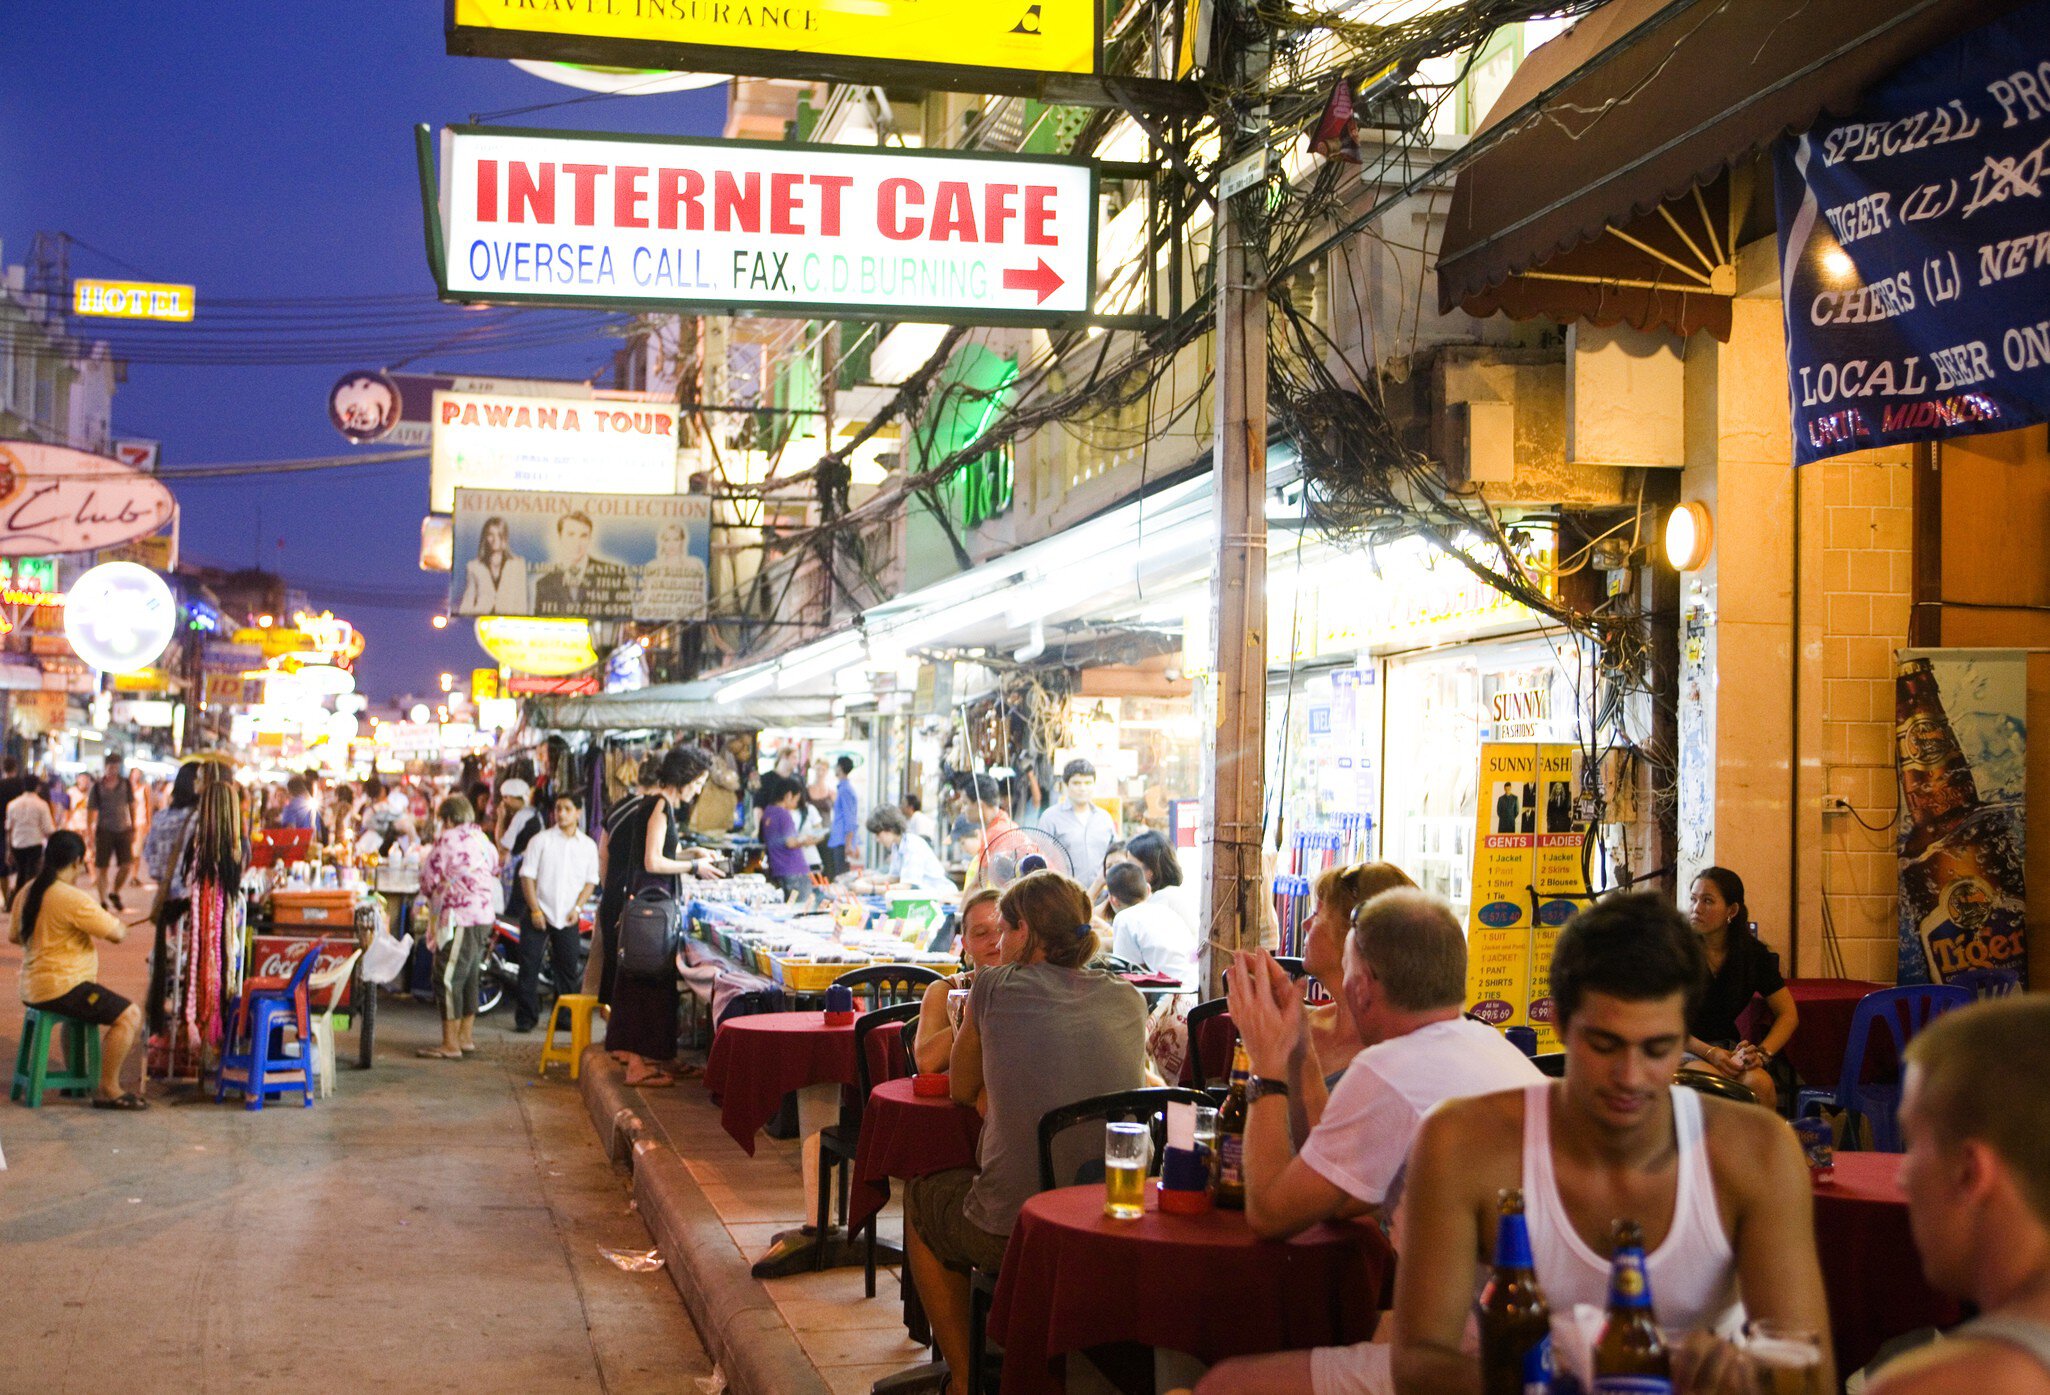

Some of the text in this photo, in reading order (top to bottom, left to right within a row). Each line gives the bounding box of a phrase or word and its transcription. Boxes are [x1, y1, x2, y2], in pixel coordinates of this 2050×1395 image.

[635, 0, 819, 31] INSURANCE
[1822, 99, 1981, 168] SPECIAL
[477, 159, 1059, 246] INTERNET CAFE
[1899, 178, 1957, 225] (L)
[469, 239, 616, 285] OVERSEA
[733, 250, 796, 294] FAX,
[1922, 251, 1960, 307] (L)
[78, 286, 189, 317] HOTEL
[1799, 356, 1927, 407] LOCAL
[1930, 340, 1995, 391] BEER
[442, 401, 673, 437] PAWANA TOUR
[1808, 408, 1870, 448] UNTIL
[8, 478, 151, 532] Club
[462, 495, 707, 518] KHAOSARN COLLECTION
[1493, 689, 1545, 722] SUNNY
[1502, 723, 1535, 738] FASHIONS
[1490, 757, 1534, 772] SUNNY
[1488, 836, 1527, 848] GENTS
[1543, 835, 1582, 847] LADIES
[1541, 866, 1546, 874] 2
[1494, 892, 1505, 900] Tie
[1487, 954, 1517, 962] JACKET
[1933, 927, 2024, 973] Tiger
[1485, 979, 1513, 987] SHIRTS
